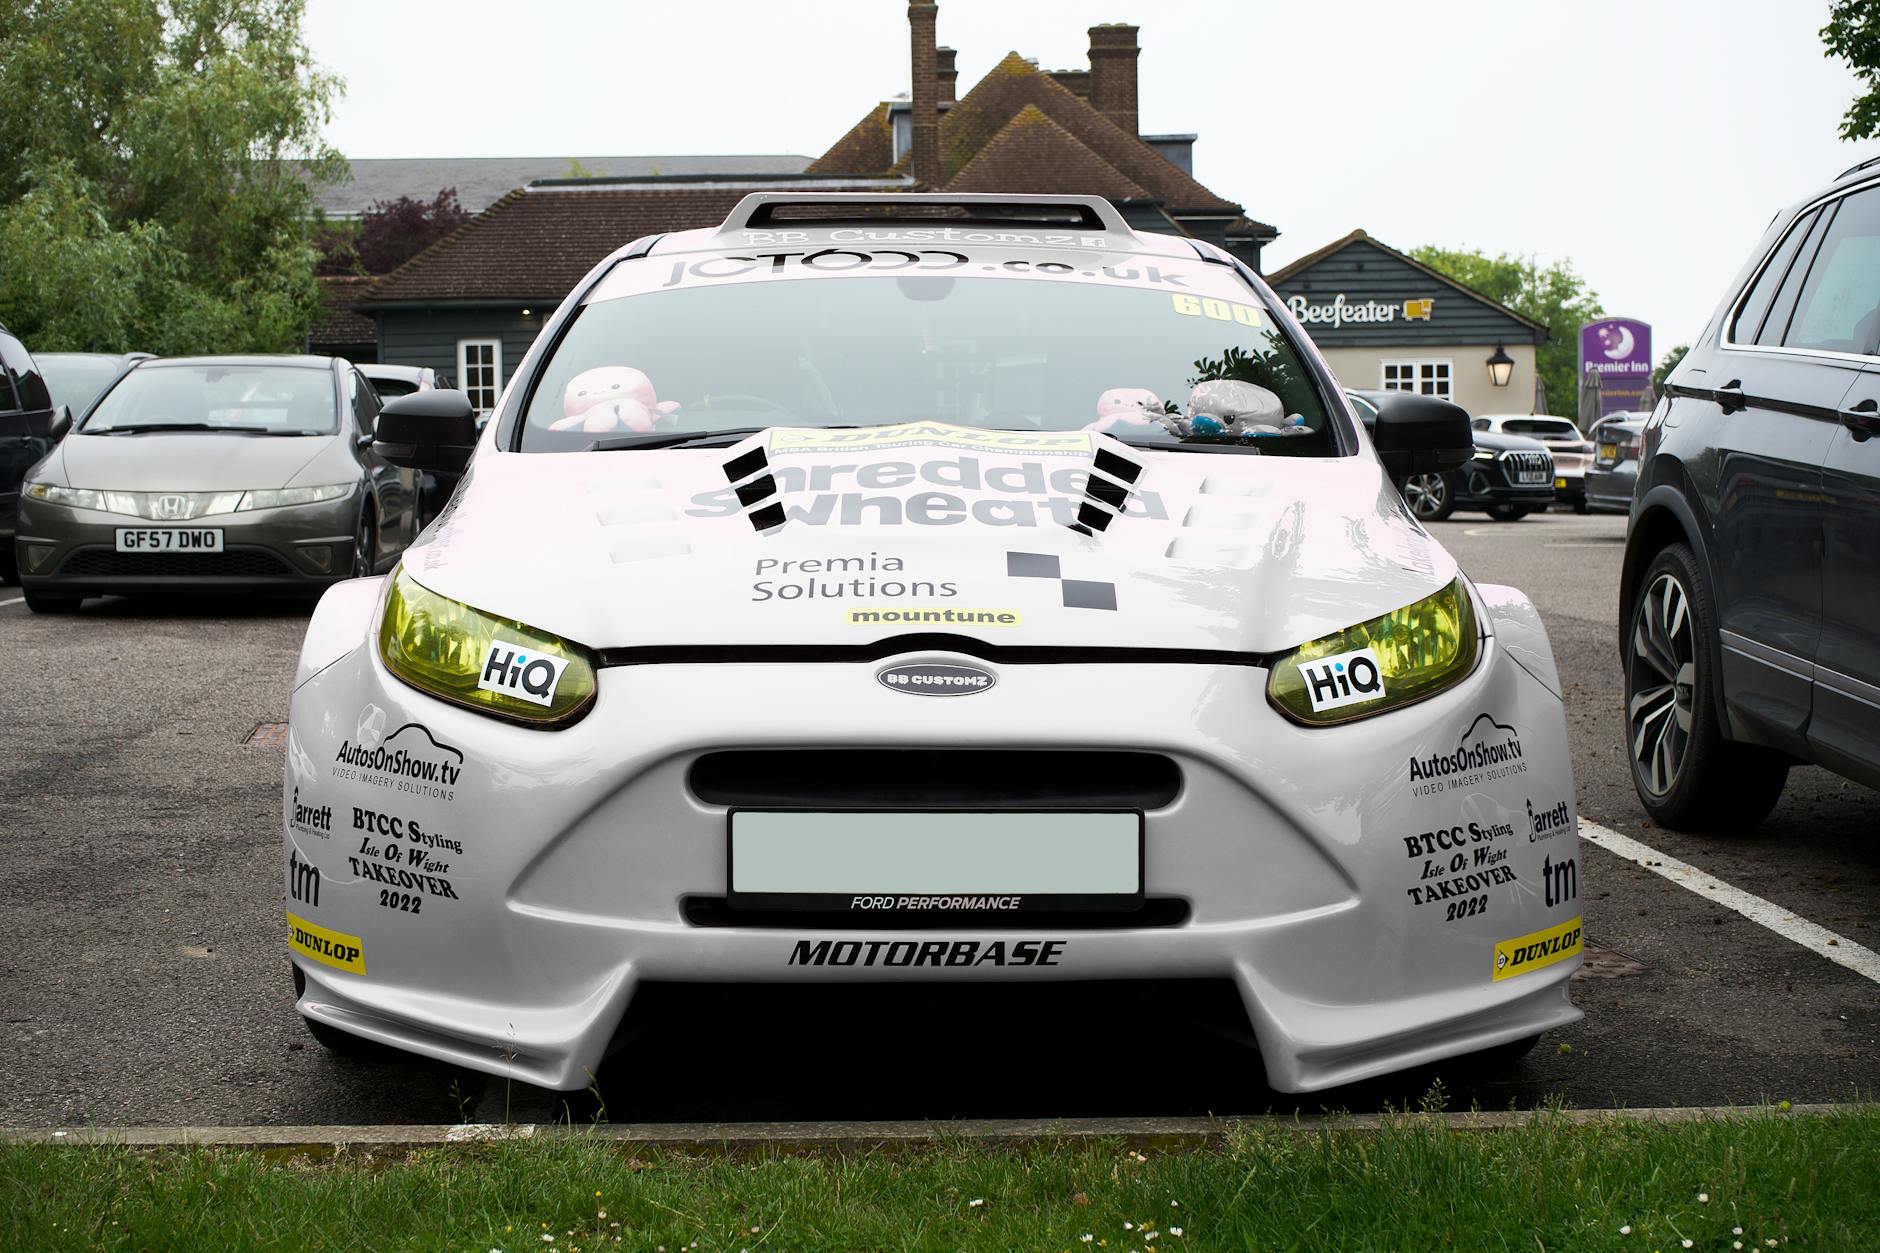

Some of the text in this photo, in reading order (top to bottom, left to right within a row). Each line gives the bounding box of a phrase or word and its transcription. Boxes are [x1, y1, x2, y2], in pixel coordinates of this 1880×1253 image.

[744, 228, 1075, 246] BB Customz
[1172, 293, 1262, 328] 600
[1287, 293, 1400, 328] Beefeater
[1631, 361, 1649, 373] Inn
[774, 439, 1089, 457] MSA British Touring Car Championship
[823, 426, 1084, 446] DUNLOP
[124, 531, 215, 548] GF57 DWO
[755, 551, 904, 576] Premia
[751, 577, 959, 602] Solutions
[851, 608, 1017, 625] mountune
[483, 647, 556, 700] HiQ
[887, 673, 988, 687] BB CUSTOMZ
[1305, 655, 1381, 703] HiQ
[336, 739, 462, 786] AutosOnShow.tv
[1409, 737, 1522, 782] AutosOnShow.tv
[332, 767, 455, 801] VIDEO IMAGERY SOLUTIONS
[1412, 762, 1528, 798] VIDEO IMAGERY SOLUTIONS
[352, 806, 404, 839] BTCC
[408, 820, 464, 855] Styling
[1403, 826, 1467, 858] BTCC
[1468, 822, 1514, 842] Styling
[359, 837, 451, 873] Isle Of Wight
[1420, 845, 1508, 880] Isle Of Wight
[289, 847, 320, 907] tm
[348, 856, 460, 900] TAKEOVER
[1407, 864, 1517, 905] TAKEOVER
[1542, 853, 1577, 908] tm
[379, 889, 423, 914] 2022
[850, 896, 1021, 910] FORD PERFORMANCE
[1445, 894, 1489, 922] 2022
[295, 927, 360, 963] DUNLOP
[787, 940, 1067, 967] MOTORBASE
[1510, 927, 1581, 967] DUNLOP
